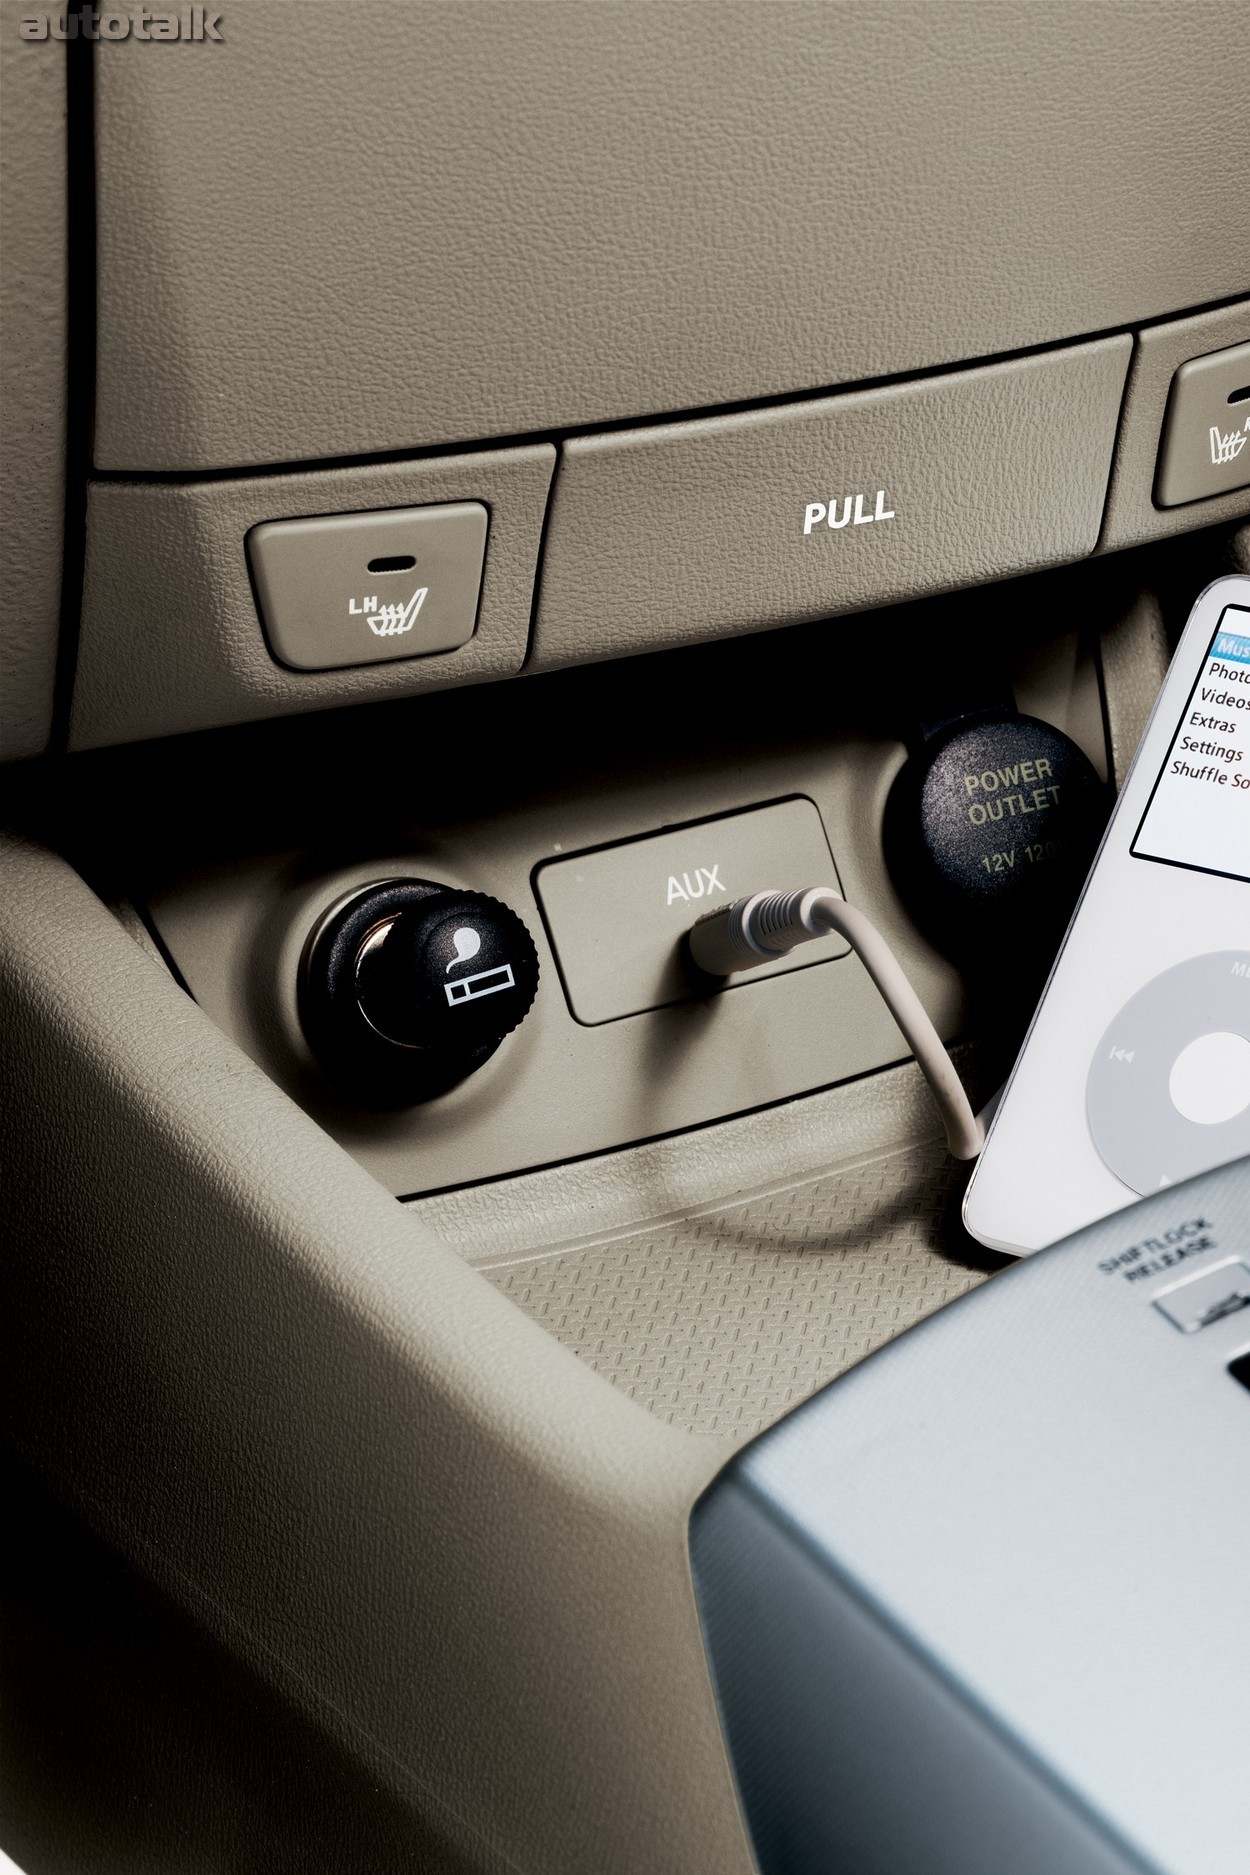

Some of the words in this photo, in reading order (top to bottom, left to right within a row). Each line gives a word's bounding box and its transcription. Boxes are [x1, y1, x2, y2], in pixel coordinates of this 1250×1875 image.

[803, 490, 895, 534] PULL
[349, 595, 378, 615] LH
[1189, 711, 1237, 735] Extras
[1180, 736, 1244, 763] Settings
[964, 758, 1054, 797] POWER
[1170, 760, 1228, 786] Shuffle
[968, 785, 1061, 826] OUTLET
[982, 850, 1016, 874] 12V
[666, 864, 726, 905] AUX
[1123, 1237, 1217, 1284] RELEASE
